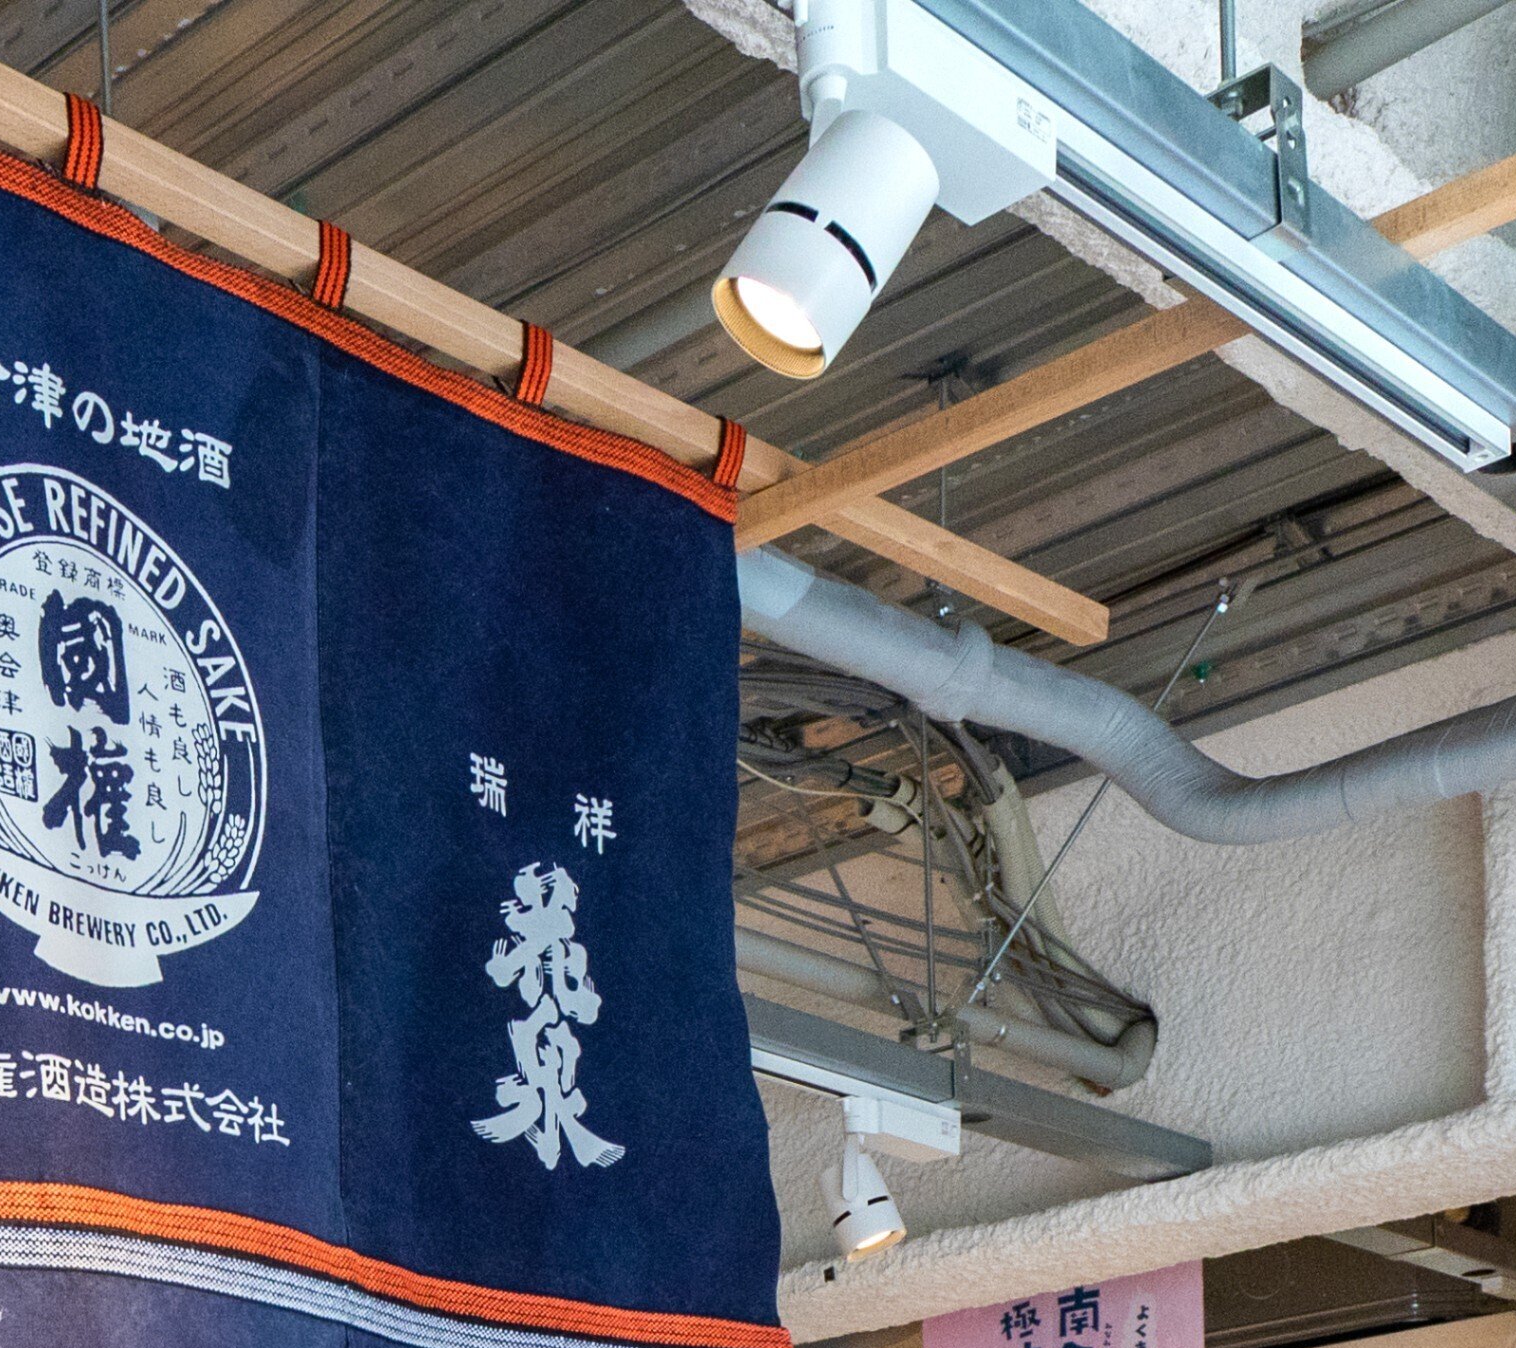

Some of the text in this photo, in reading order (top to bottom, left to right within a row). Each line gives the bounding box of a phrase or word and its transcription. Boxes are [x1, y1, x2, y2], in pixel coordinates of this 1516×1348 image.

[32, 549, 127, 601] 登録商標
[43, 477, 187, 611] REFINED
[185, 617, 257, 745] SAKE
[128, 622, 167, 646] MARK
[163, 666, 193, 798] 酒も良し
[137, 683, 167, 845] 人情も良し
[69, 851, 128, 883] こっけん
[48, 903, 136, 948] BREWERY
